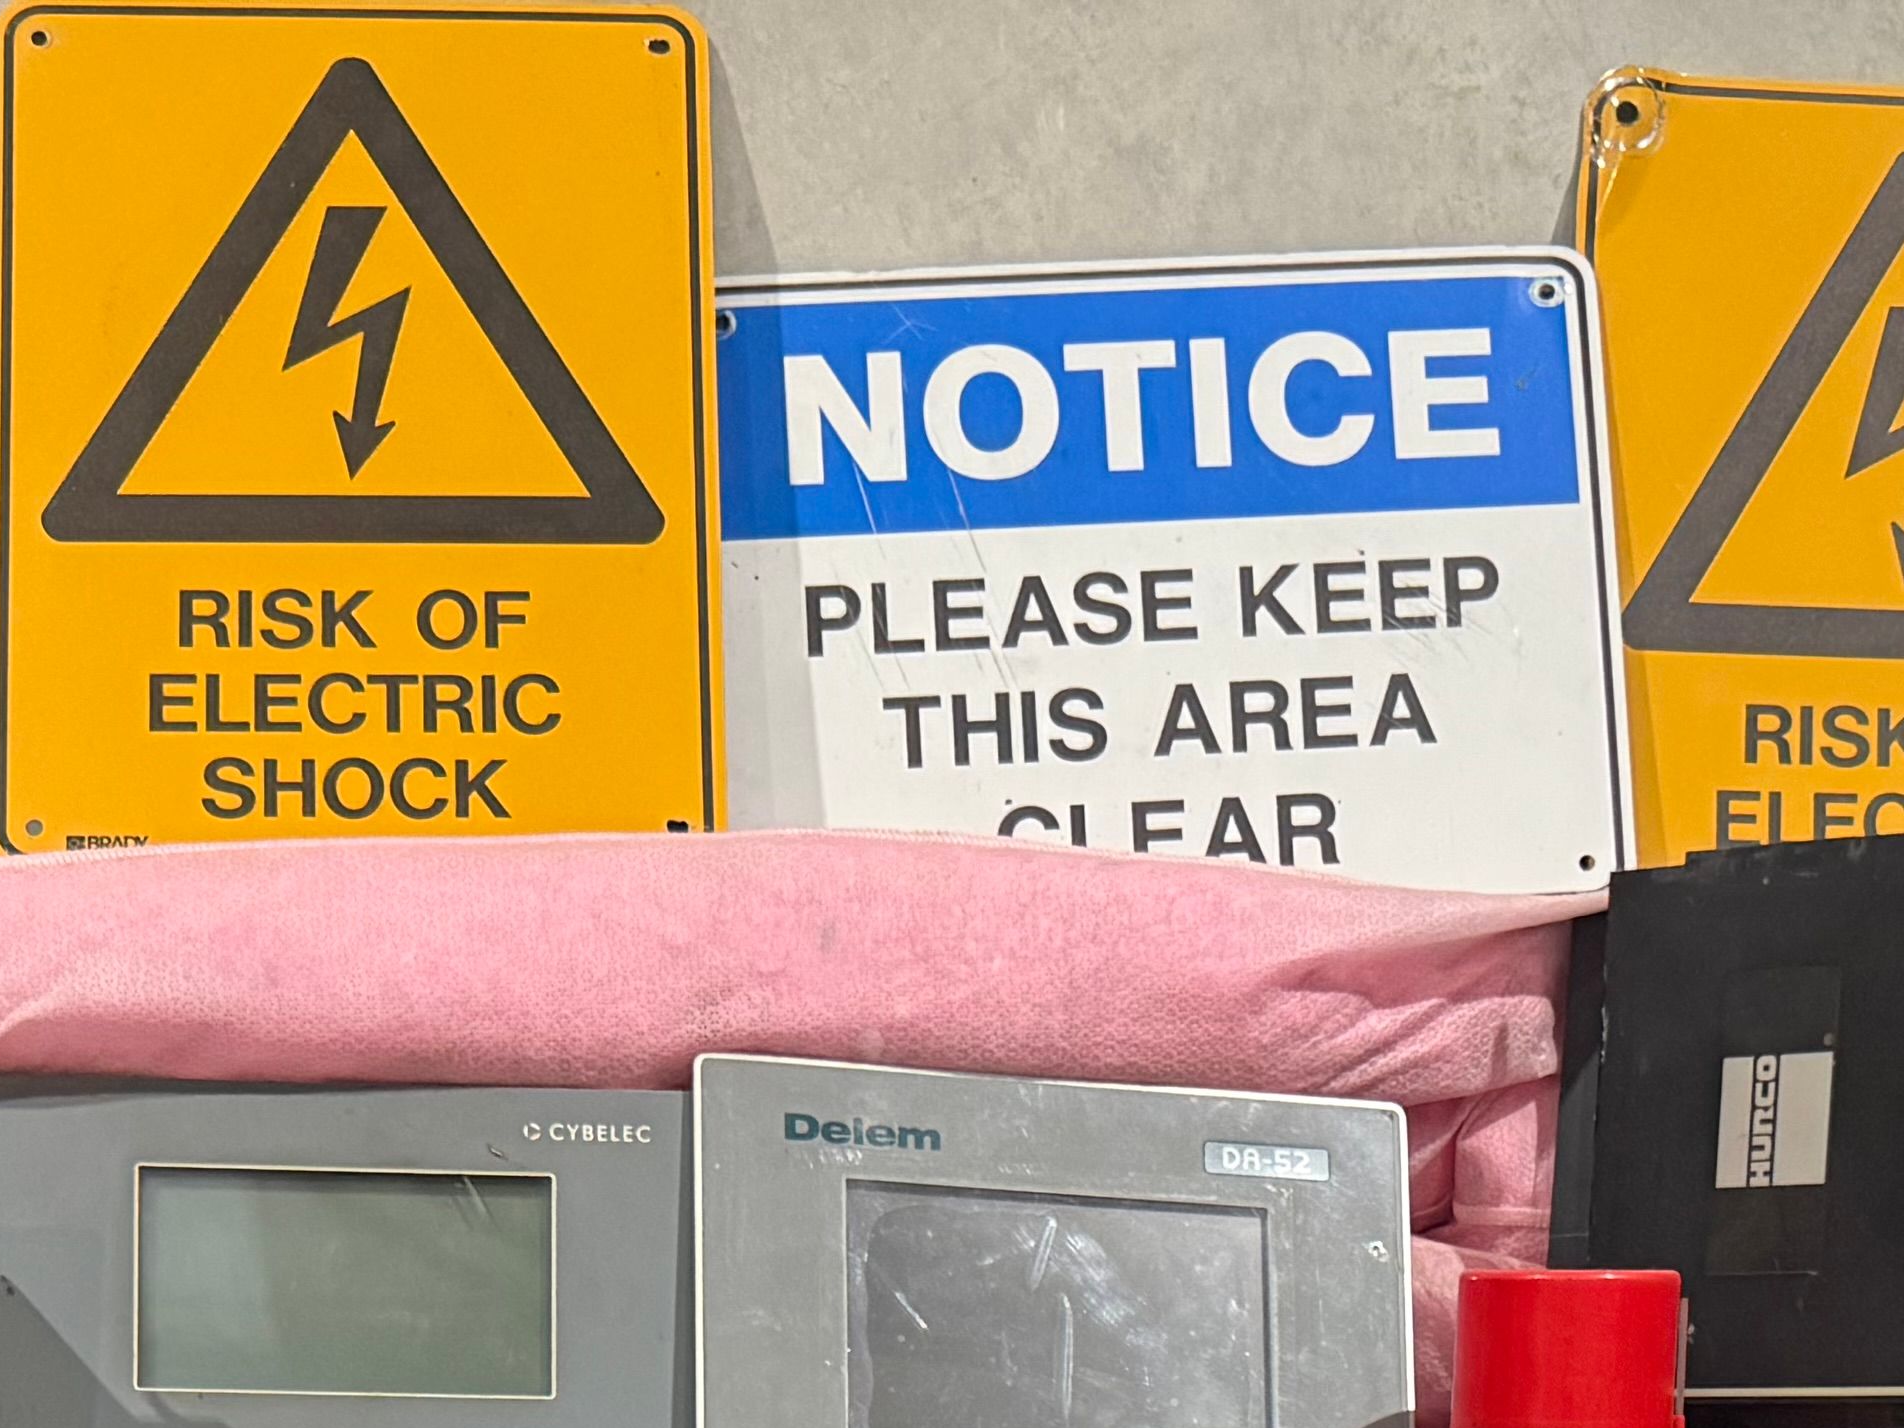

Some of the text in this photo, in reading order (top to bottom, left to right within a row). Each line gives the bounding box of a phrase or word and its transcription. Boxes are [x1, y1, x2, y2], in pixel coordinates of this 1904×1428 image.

[783, 326, 1501, 486] NOTICE
[179, 589, 531, 648] RISK OF
[805, 555, 1499, 658] PLEASE KEEP
[148, 673, 561, 737] ELECTRIC
[883, 672, 1437, 769] THIS AREA
[201, 758, 512, 820] SHOCK
[549, 1123, 651, 1144] CYBELEC
[784, 1111, 941, 1151] Delem
[1749, 1055, 1777, 1187] HURCO
[1222, 1146, 1310, 1175] DA-52
